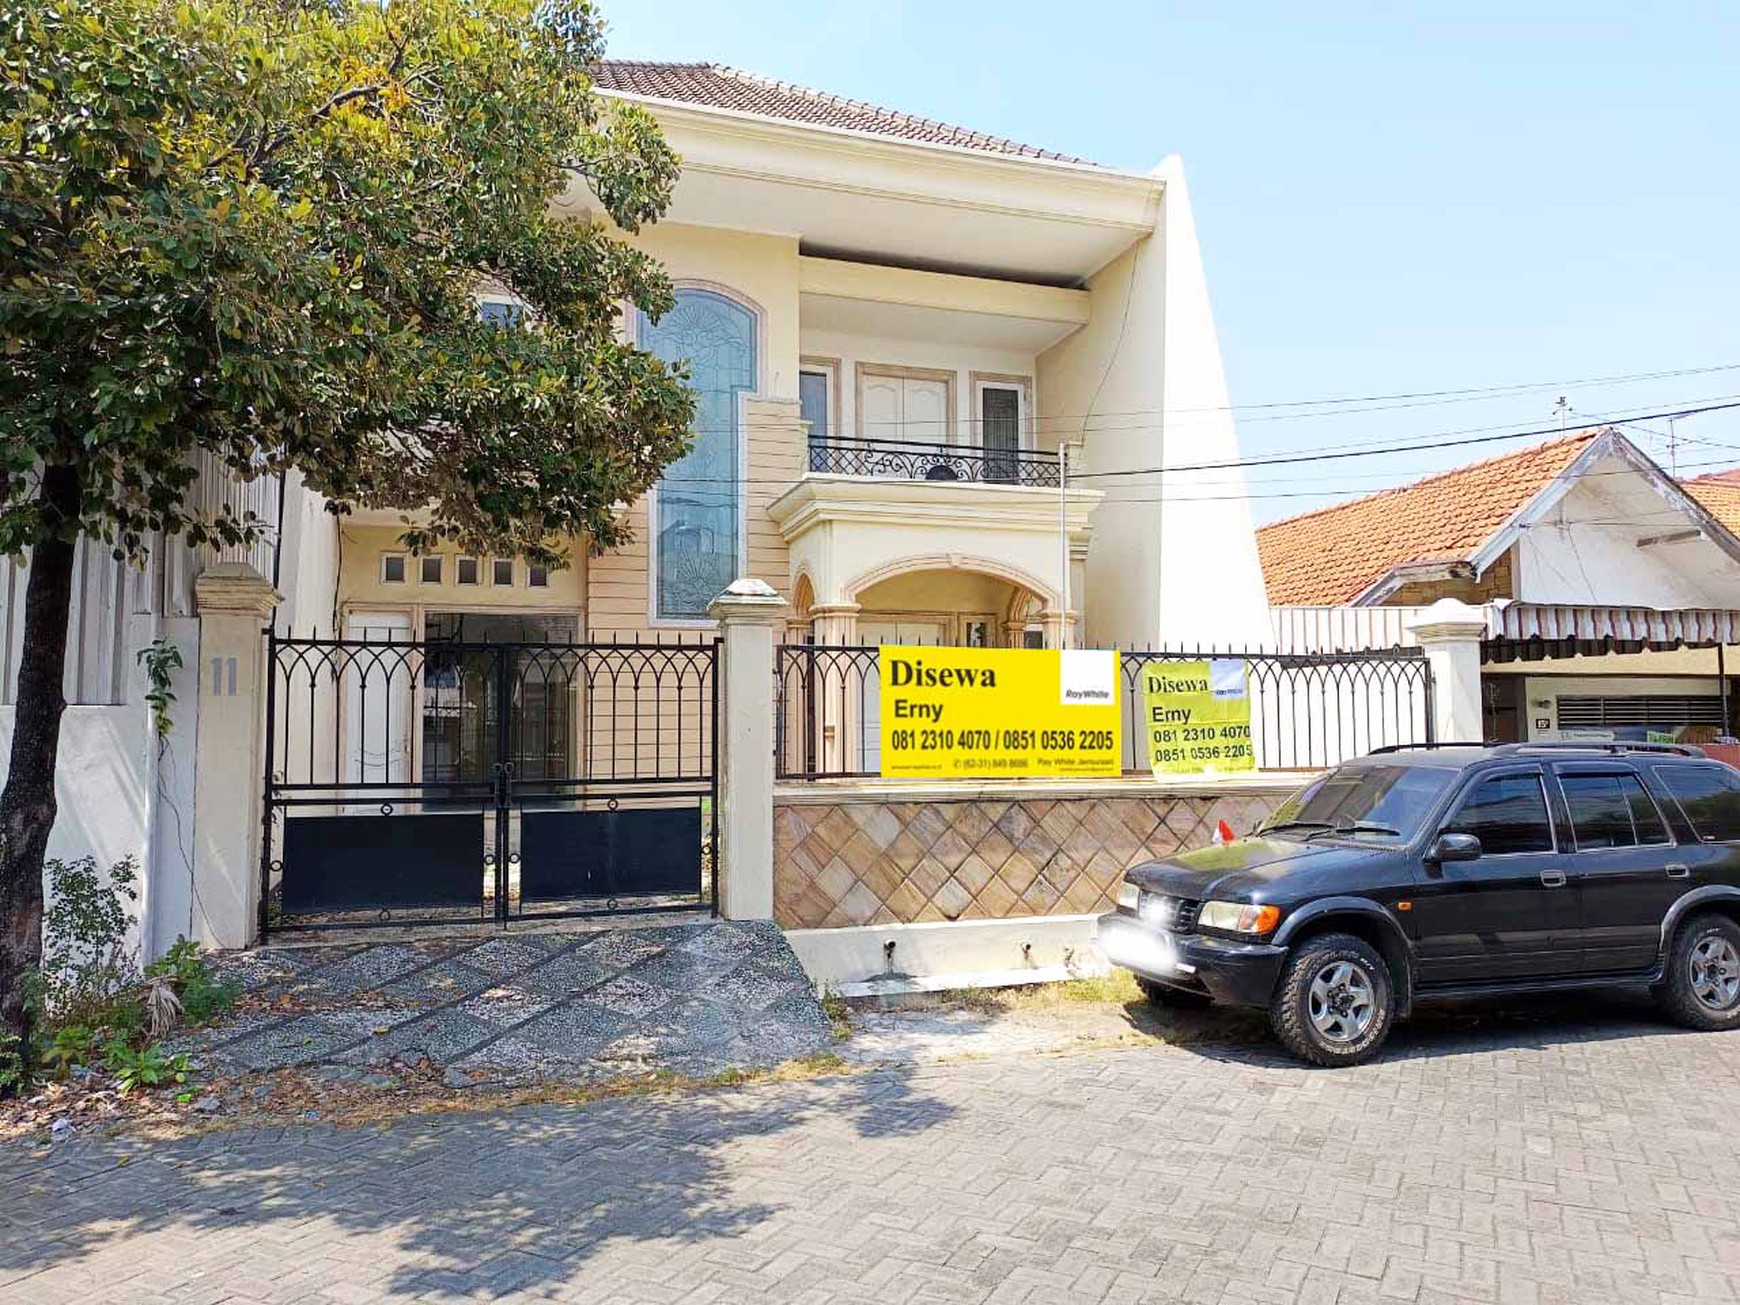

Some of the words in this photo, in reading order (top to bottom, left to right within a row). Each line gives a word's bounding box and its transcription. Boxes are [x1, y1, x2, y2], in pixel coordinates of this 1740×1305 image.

[211, 657, 237, 696] 11
[890, 659, 996, 688] Disewa
[1148, 675, 1208, 693] Disewa
[894, 699, 943, 723] Erny
[1152, 706, 1191, 725] Erny
[892, 730, 916, 750] 081
[920, 730, 954, 750] 2310
[957, 730, 991, 750] 4070
[994, 730, 1000, 750] /
[1003, 730, 1036, 751] 0851
[1041, 730, 1075, 751] 0536
[1079, 730, 1114, 751] 2205
[1153, 729, 1177, 743] 081
[1183, 727, 1215, 741] 2310
[1220, 725, 1251, 739] 4070
[1155, 748, 1186, 762] 0851
[1190, 746, 1220, 759] 0536
[1224, 744, 1253, 758] 2205
